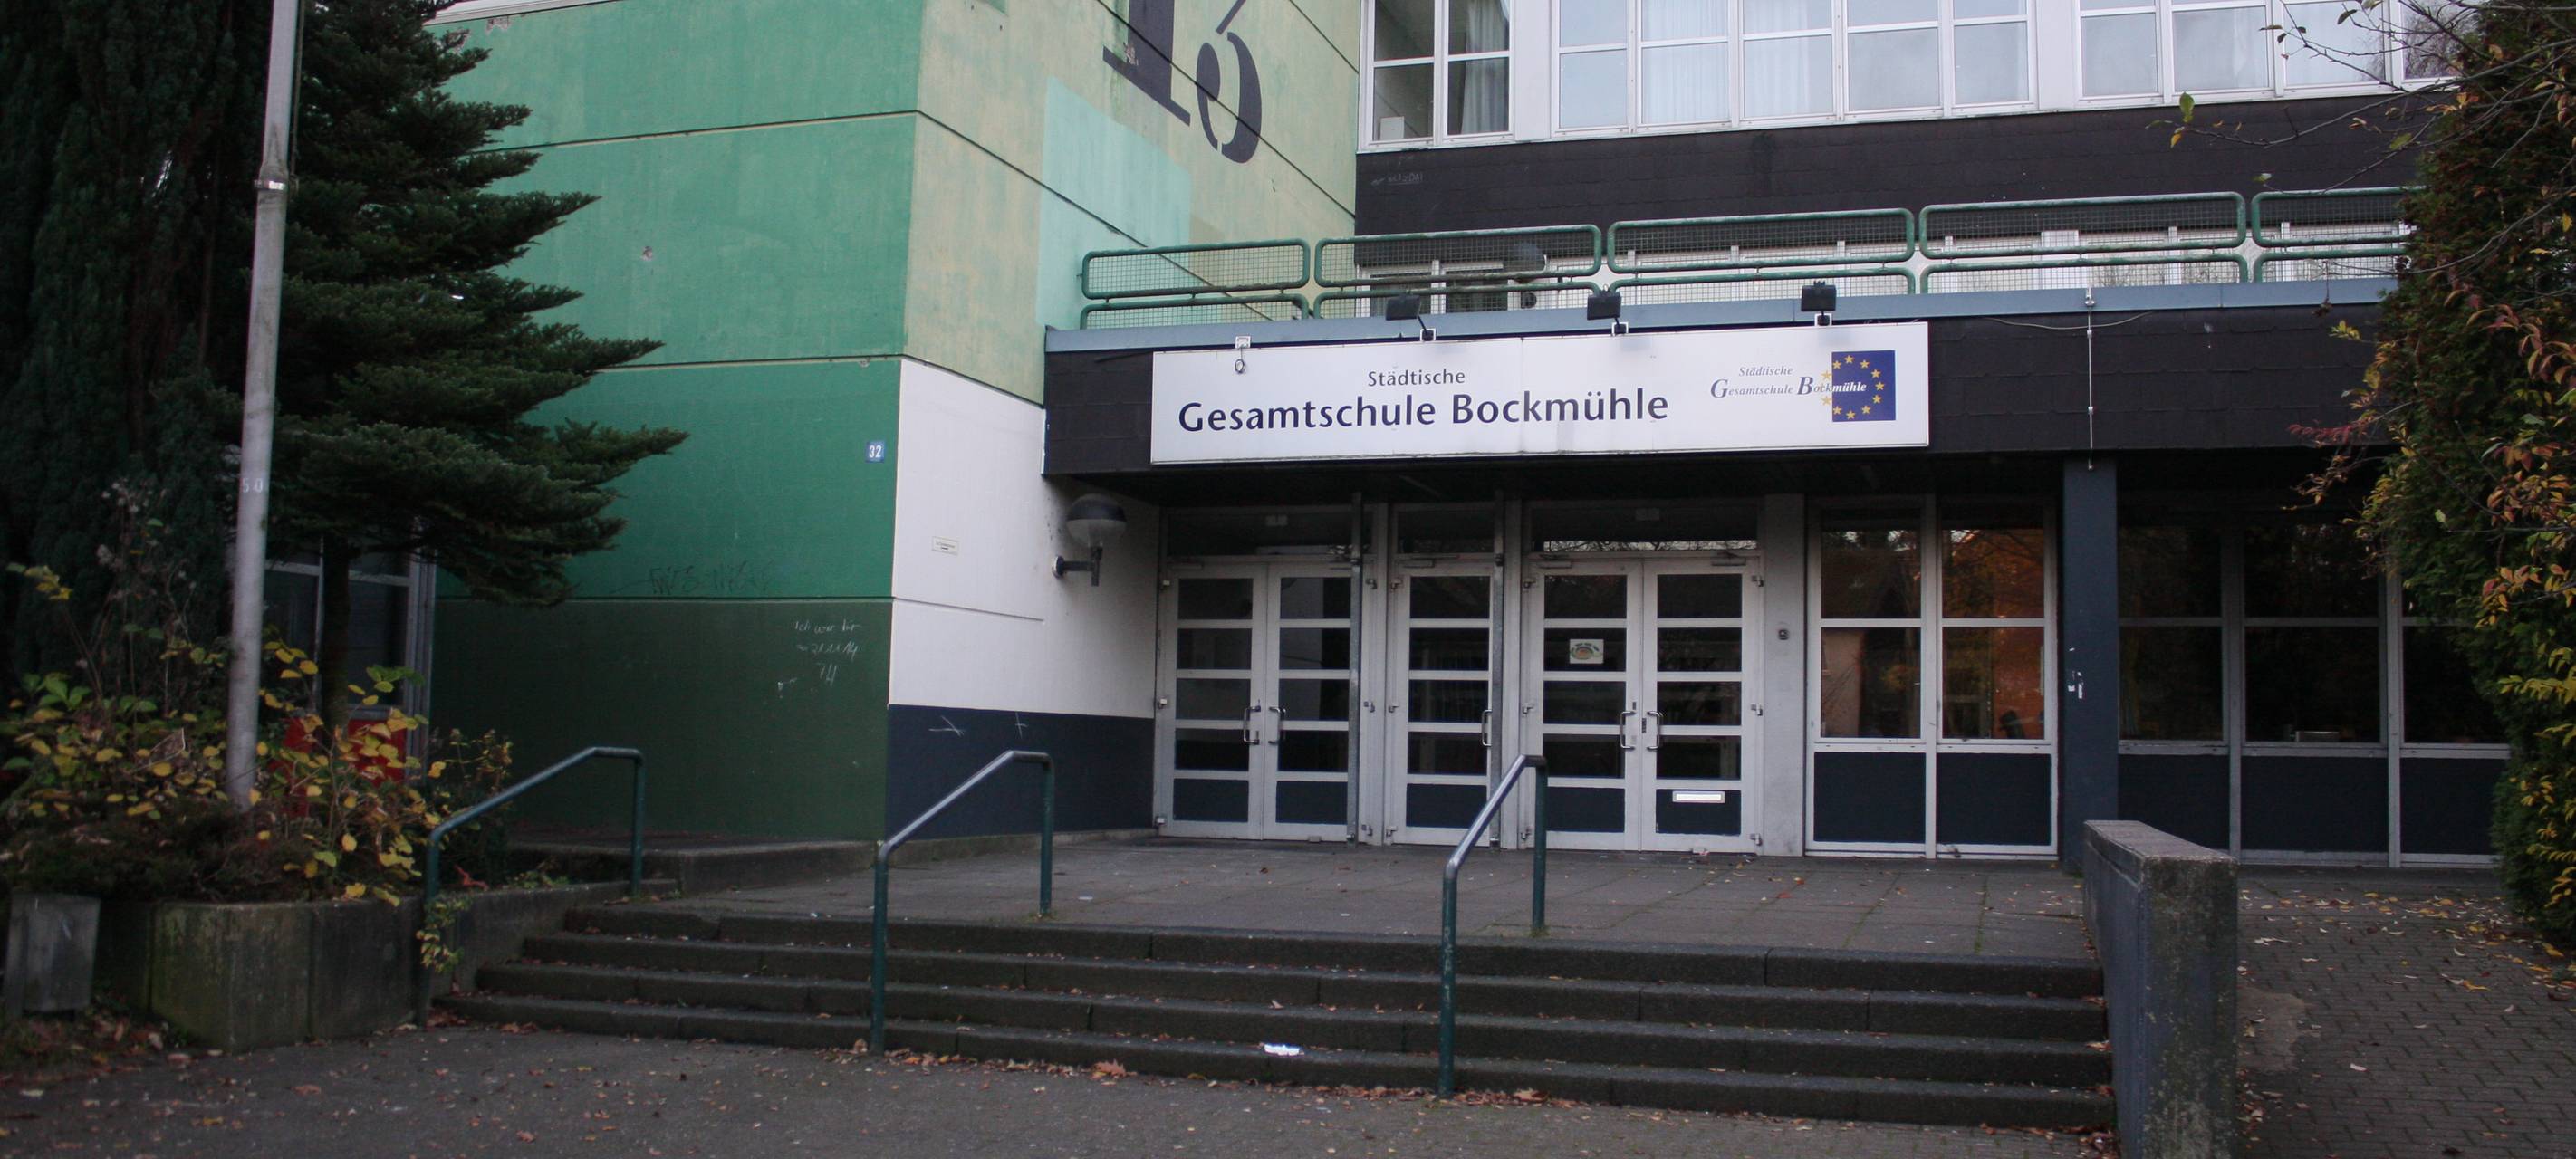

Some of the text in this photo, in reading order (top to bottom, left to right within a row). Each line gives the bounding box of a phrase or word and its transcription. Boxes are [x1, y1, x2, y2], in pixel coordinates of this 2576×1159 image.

[1368, 368, 1466, 387] Städtische
[1738, 366, 1793, 377] Städtische
[1710, 376, 1867, 398] Gesamtschule Bockmühle
[1178, 387, 1669, 432] Gesamtschule Bockmühle
[869, 445, 882, 458] 32
